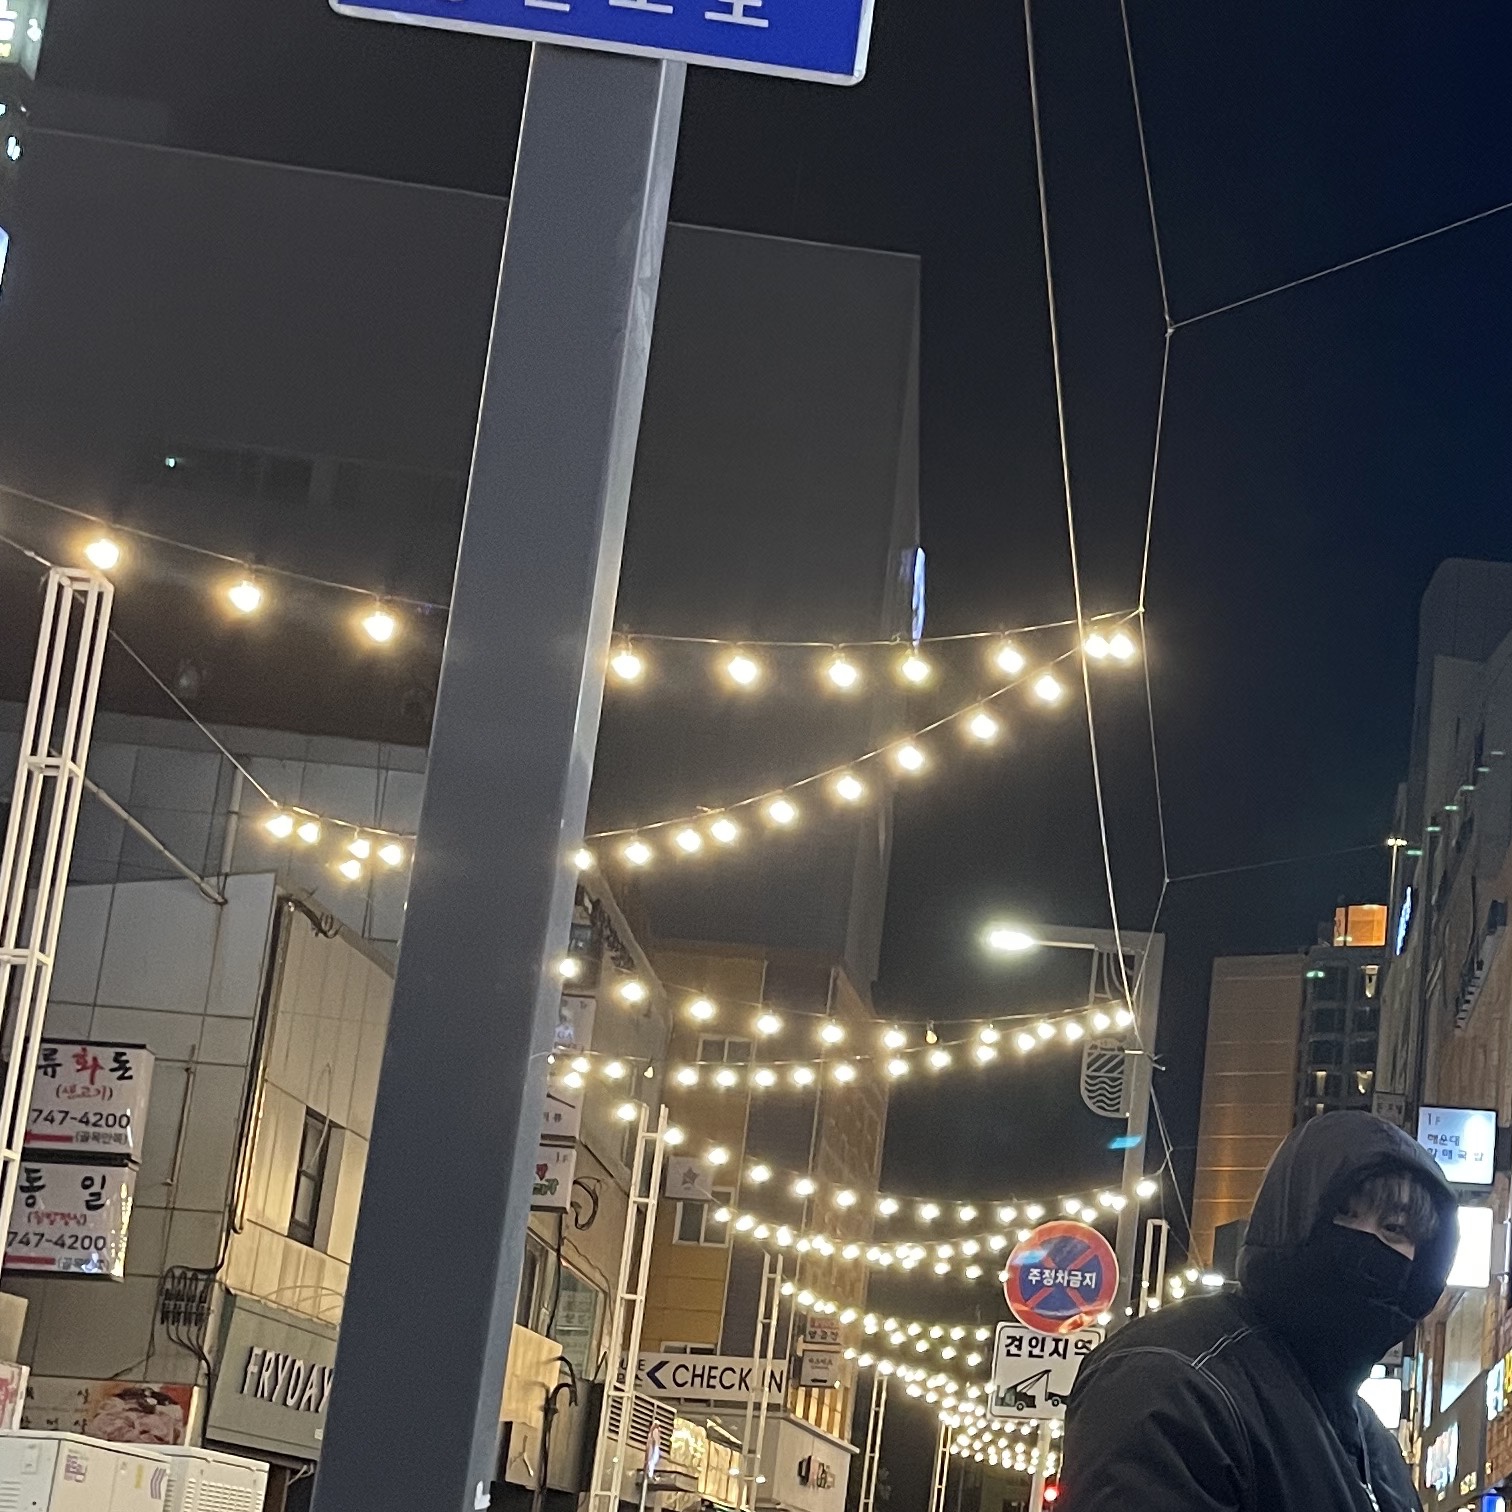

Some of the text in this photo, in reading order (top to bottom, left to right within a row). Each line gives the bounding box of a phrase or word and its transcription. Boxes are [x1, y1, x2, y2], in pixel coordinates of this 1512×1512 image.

[31, 1108, 130, 1129] 747-4200
[7, 1231, 106, 1251] 747-4200
[1028, 1268, 1096, 1288] 주정차금지
[240, 1346, 334, 1413] FRYDAY
[672, 1363, 752, 1392] CHECK
[763, 1370, 783, 1393] IN
